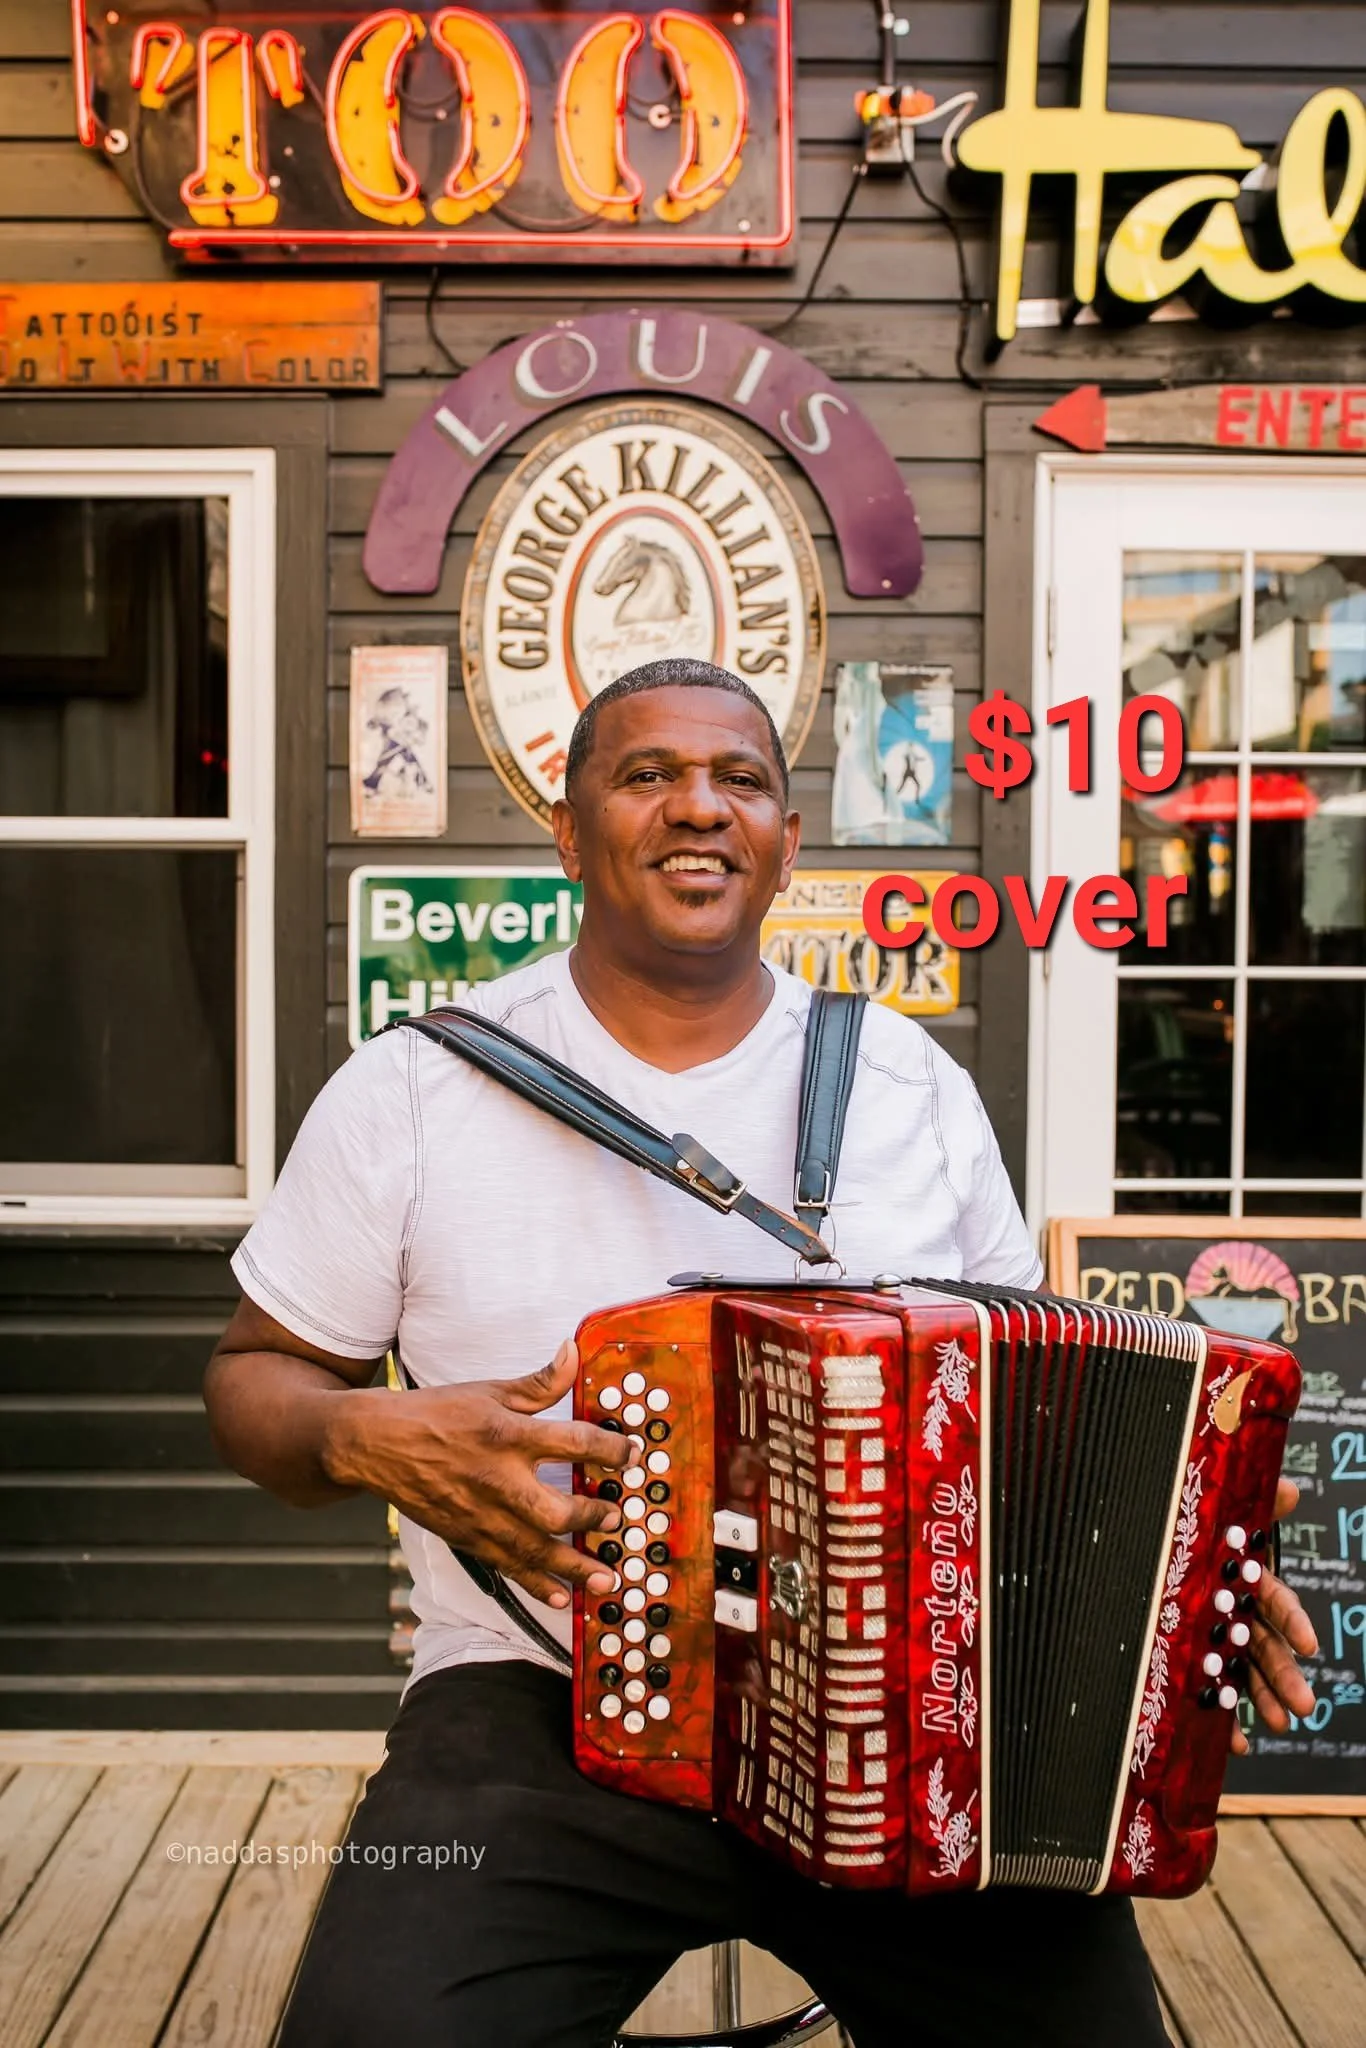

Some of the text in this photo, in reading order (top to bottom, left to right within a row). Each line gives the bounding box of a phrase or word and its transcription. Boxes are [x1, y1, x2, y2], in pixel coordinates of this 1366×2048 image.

[130, 7, 751, 226] TOO
[243, 341, 370, 383] COLOR
[435, 319, 849, 457] LOUIS
[499, 438, 790, 678] GEORGE KILLIAN'S
[1080, 1267, 1186, 1321] RED
